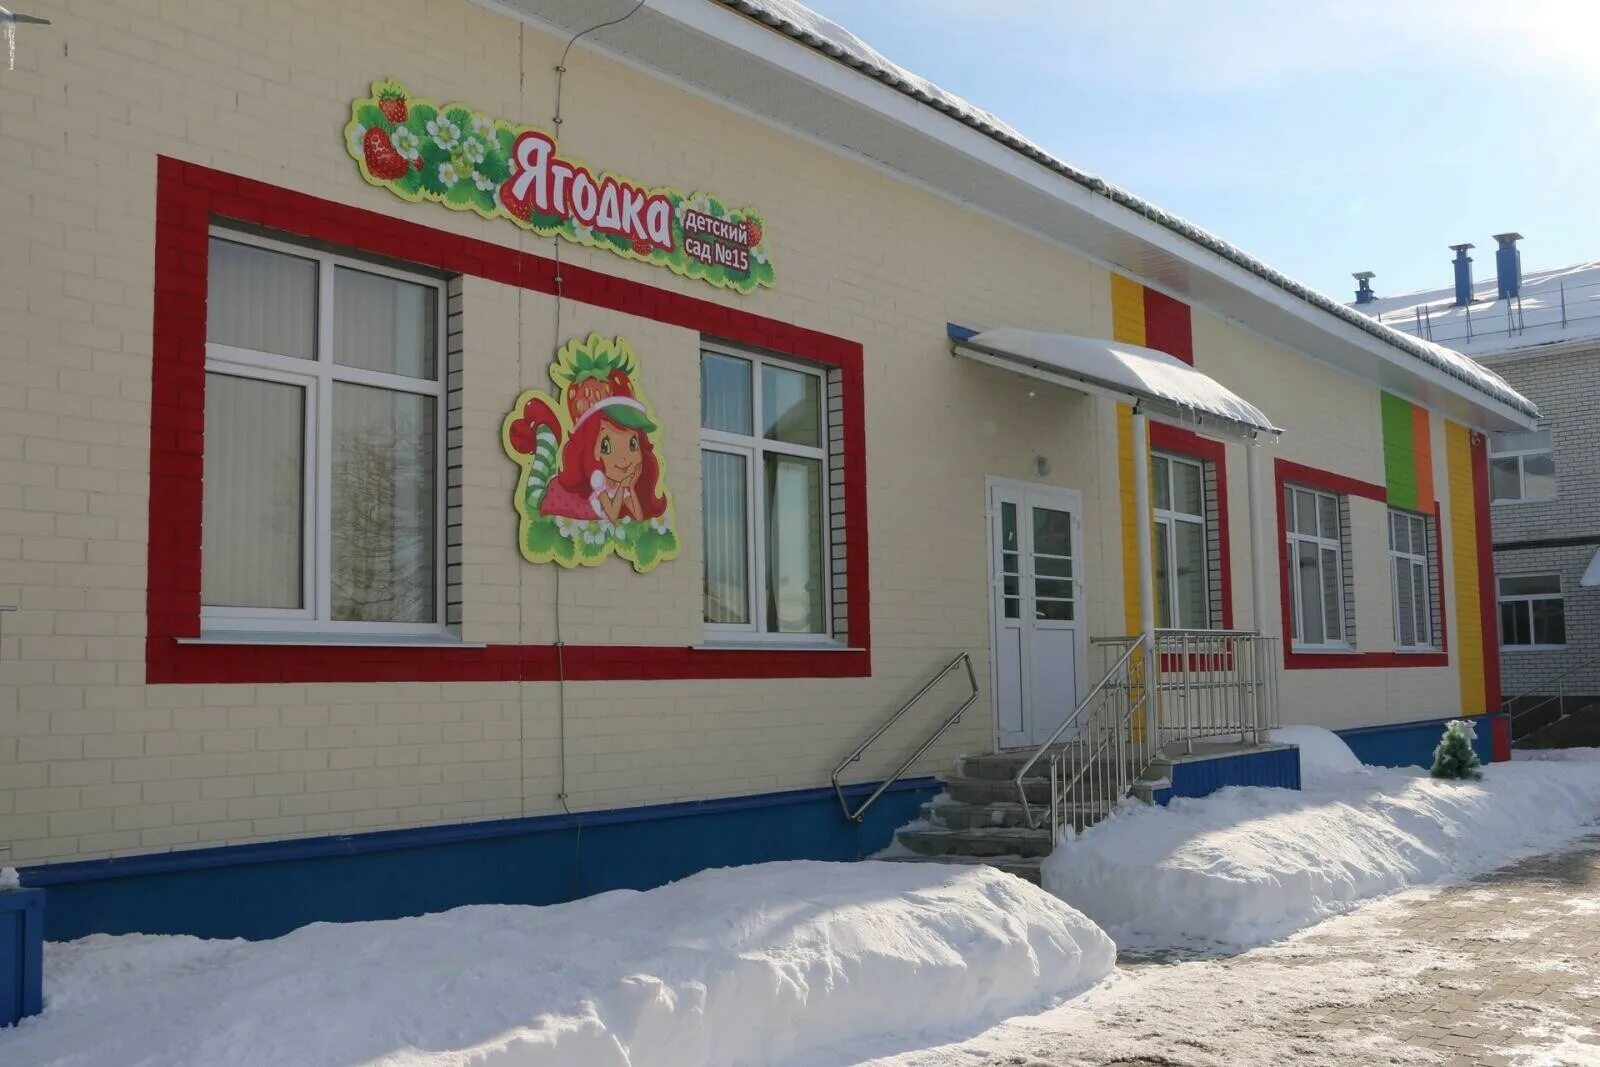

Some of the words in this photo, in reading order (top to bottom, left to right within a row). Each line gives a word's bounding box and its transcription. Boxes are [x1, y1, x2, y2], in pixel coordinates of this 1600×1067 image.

[513, 137, 671, 247] Ягодка
[685, 212, 748, 245] детский
[685, 238, 712, 264] сад
[715, 243, 749, 271] №15
